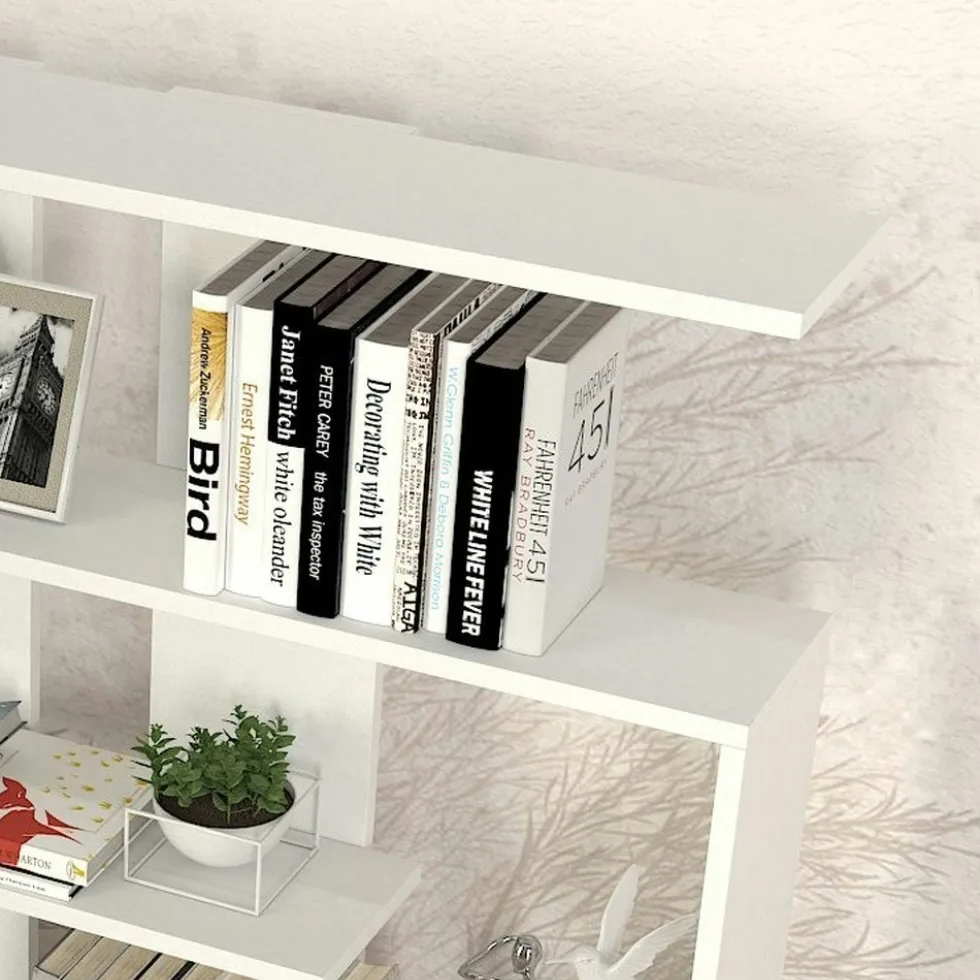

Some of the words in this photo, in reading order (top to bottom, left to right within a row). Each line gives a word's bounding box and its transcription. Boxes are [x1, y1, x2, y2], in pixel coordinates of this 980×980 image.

[199, 327, 212, 372] Andrew
[280, 325, 301, 389] Janet
[197, 371, 212, 430] Zuckerman
[240, 382, 258, 431] Ernest
[318, 365, 333, 410] PETER
[572, 352, 619, 418] FAHRENHEIT
[277, 388, 298, 441] Fitch
[315, 414, 332, 458] CAREY
[355, 378, 391, 478] Decorating
[567, 385, 614, 472] 451
[439, 430, 454, 475] Griffin
[522, 427, 535, 469] RAY
[186, 437, 220, 541] Bird
[233, 435, 256, 526] Hemingway
[273, 451, 294, 503] white
[313, 471, 328, 494] the
[359, 482, 385, 520] with
[470, 469, 494, 530] WHITE
[529, 438, 557, 537] FAHRENHEIT
[312, 497, 326, 517] tax
[511, 476, 532, 584] BRADBURY
[270, 507, 292, 587] oleander
[308, 521, 326, 581] inspector
[355, 526, 382, 576] White
[466, 529, 489, 577] LINE
[525, 540, 547, 584] 451
[401, 581, 418, 634] AIGA
[430, 552, 446, 610] Morrison
[461, 577, 486, 637] FEVER
